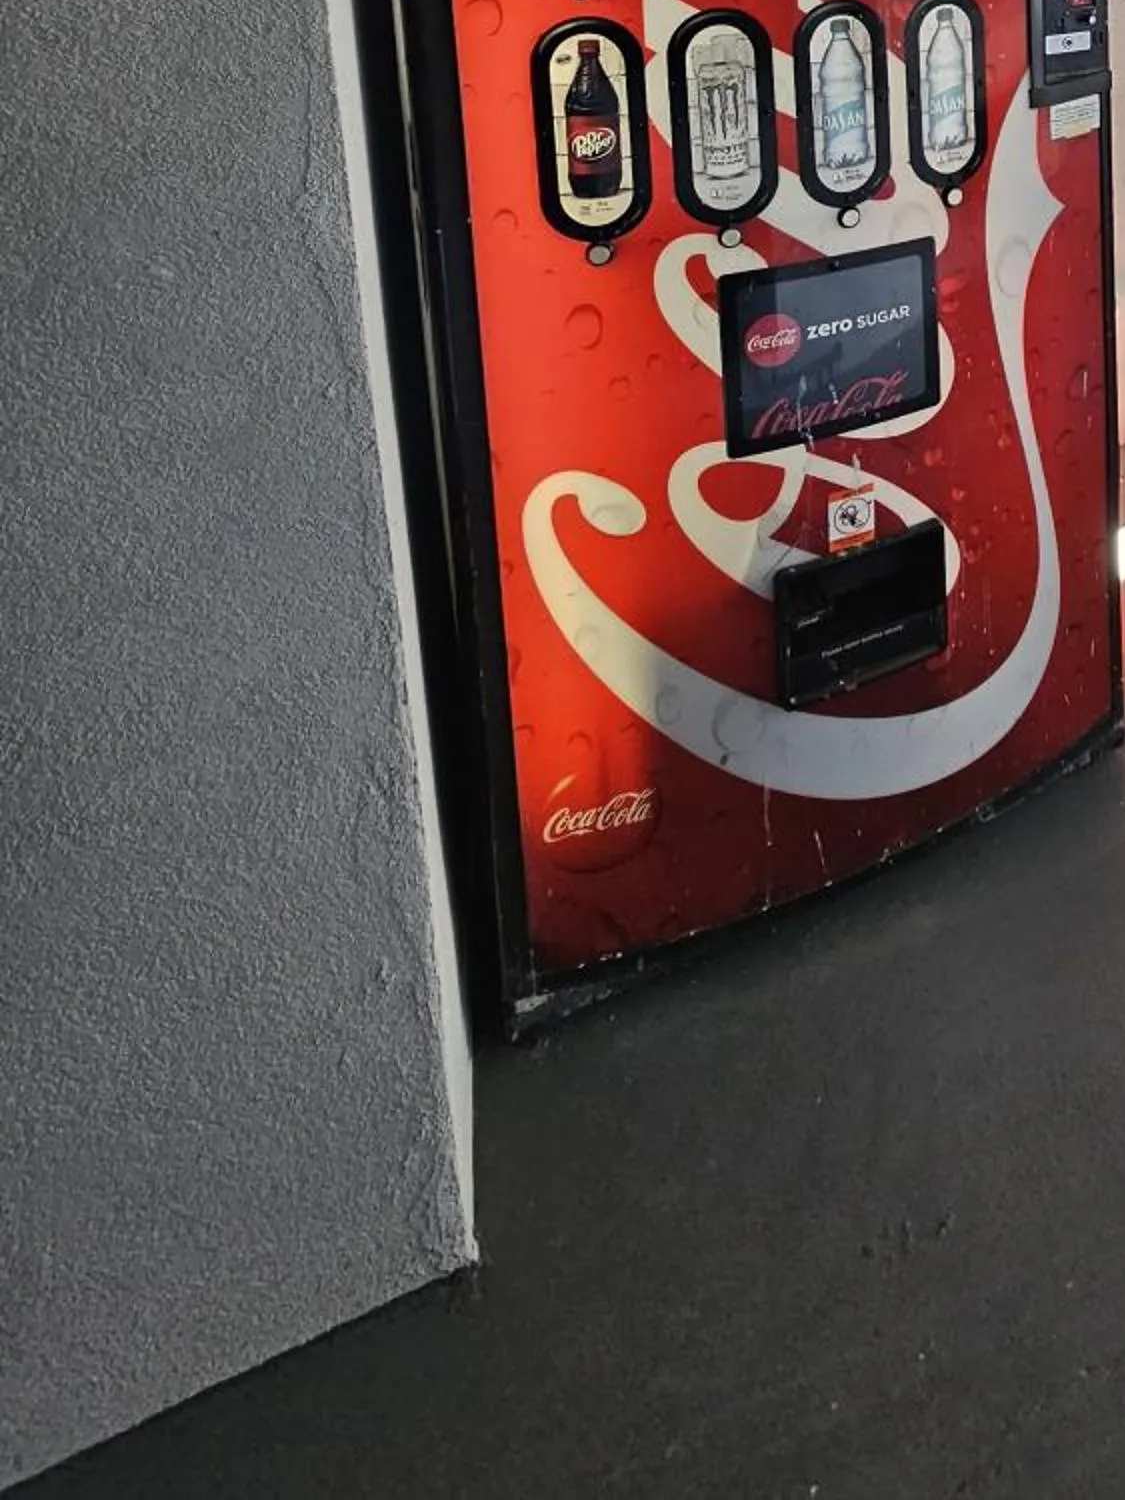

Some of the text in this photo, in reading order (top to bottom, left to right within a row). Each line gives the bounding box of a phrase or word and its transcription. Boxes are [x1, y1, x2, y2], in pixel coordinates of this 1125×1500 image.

[574, 134, 613, 158] Pepper
[806, 305, 911, 340] zero SUGAR
